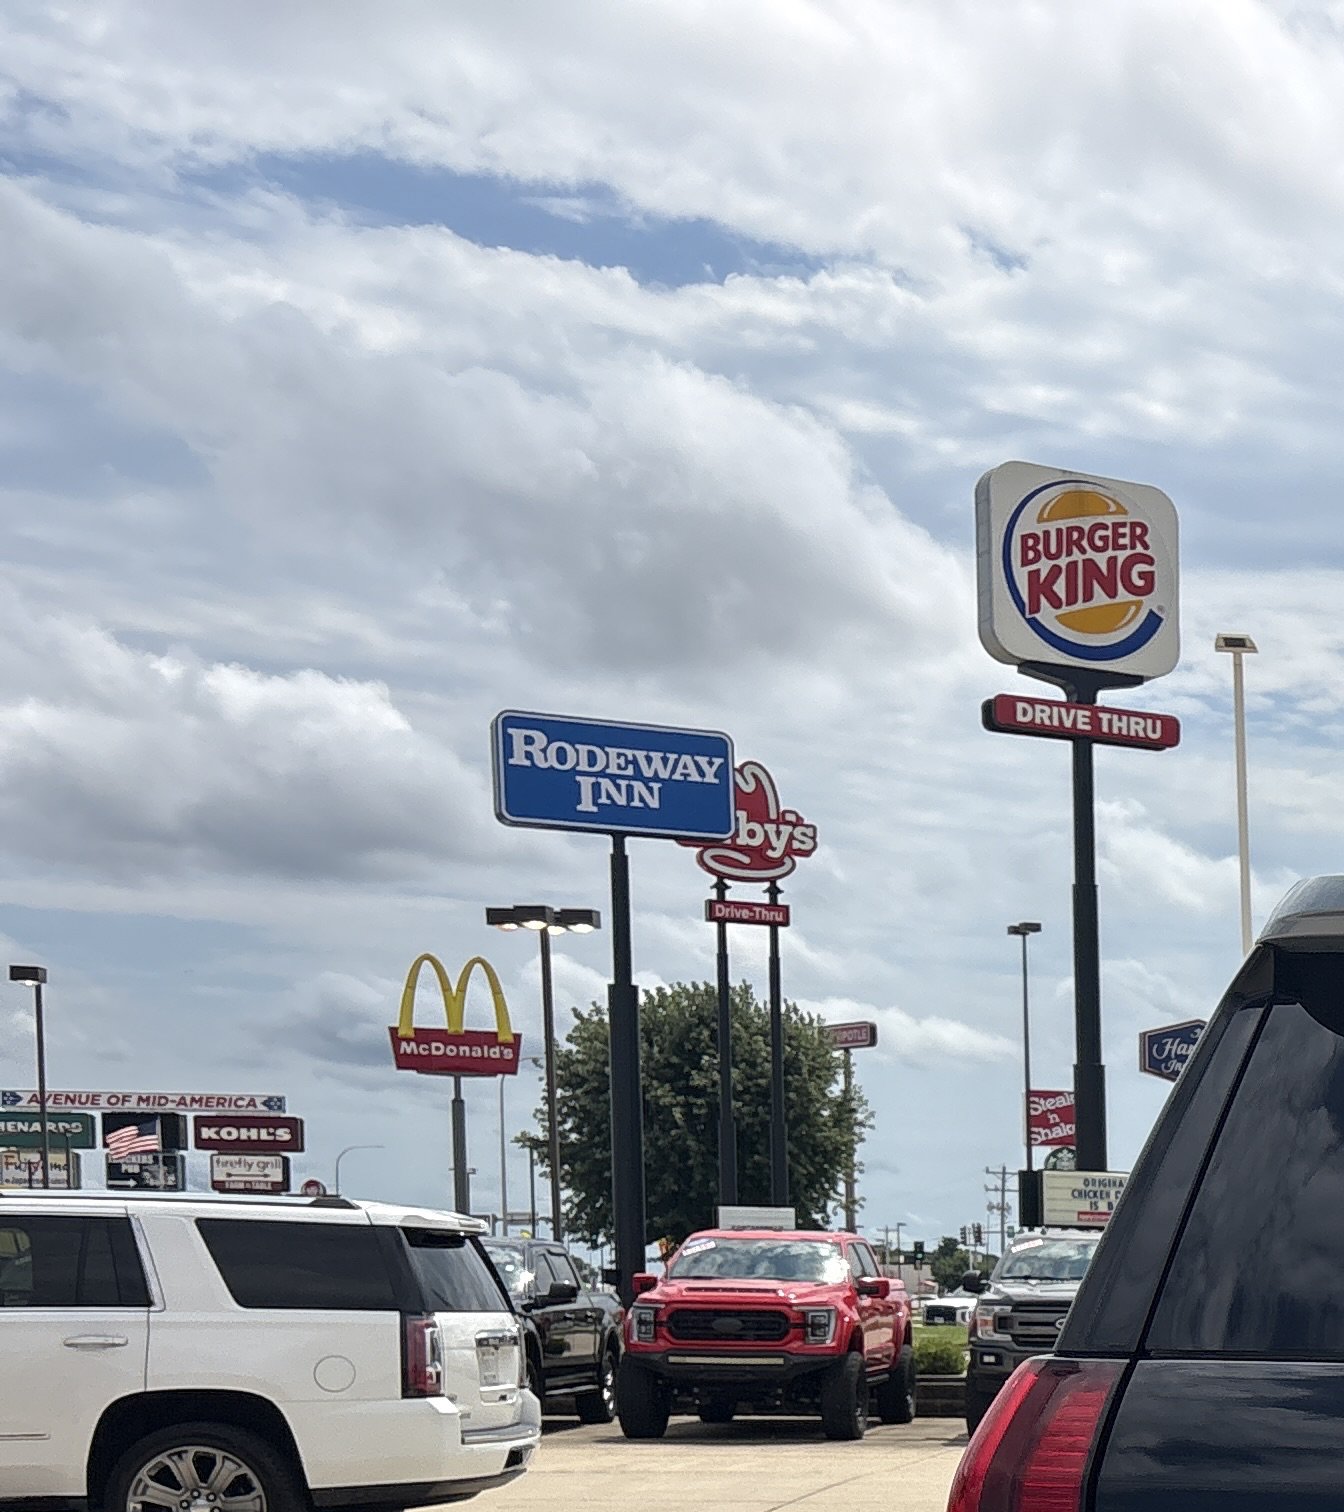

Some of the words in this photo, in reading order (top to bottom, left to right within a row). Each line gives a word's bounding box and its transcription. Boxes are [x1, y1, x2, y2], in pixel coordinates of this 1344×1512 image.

[1020, 520, 1150, 568] BURGER
[1027, 552, 1156, 616] KING
[1015, 701, 1092, 732] DRIVE
[1099, 712, 1162, 740] THRU
[507, 727, 725, 785] RODEWAY
[575, 775, 662, 813] INN
[735, 809, 816, 858] by's
[715, 904, 784, 921] Drive-Thru
[400, 1041, 514, 1060] McDonald's
[106, 1094, 132, 1106] OF
[136, 1095, 258, 1109] MID-AMERICA
[200, 1126, 292, 1141] KOHL'S
[1083, 1178, 1124, 1188] ORIGINA
